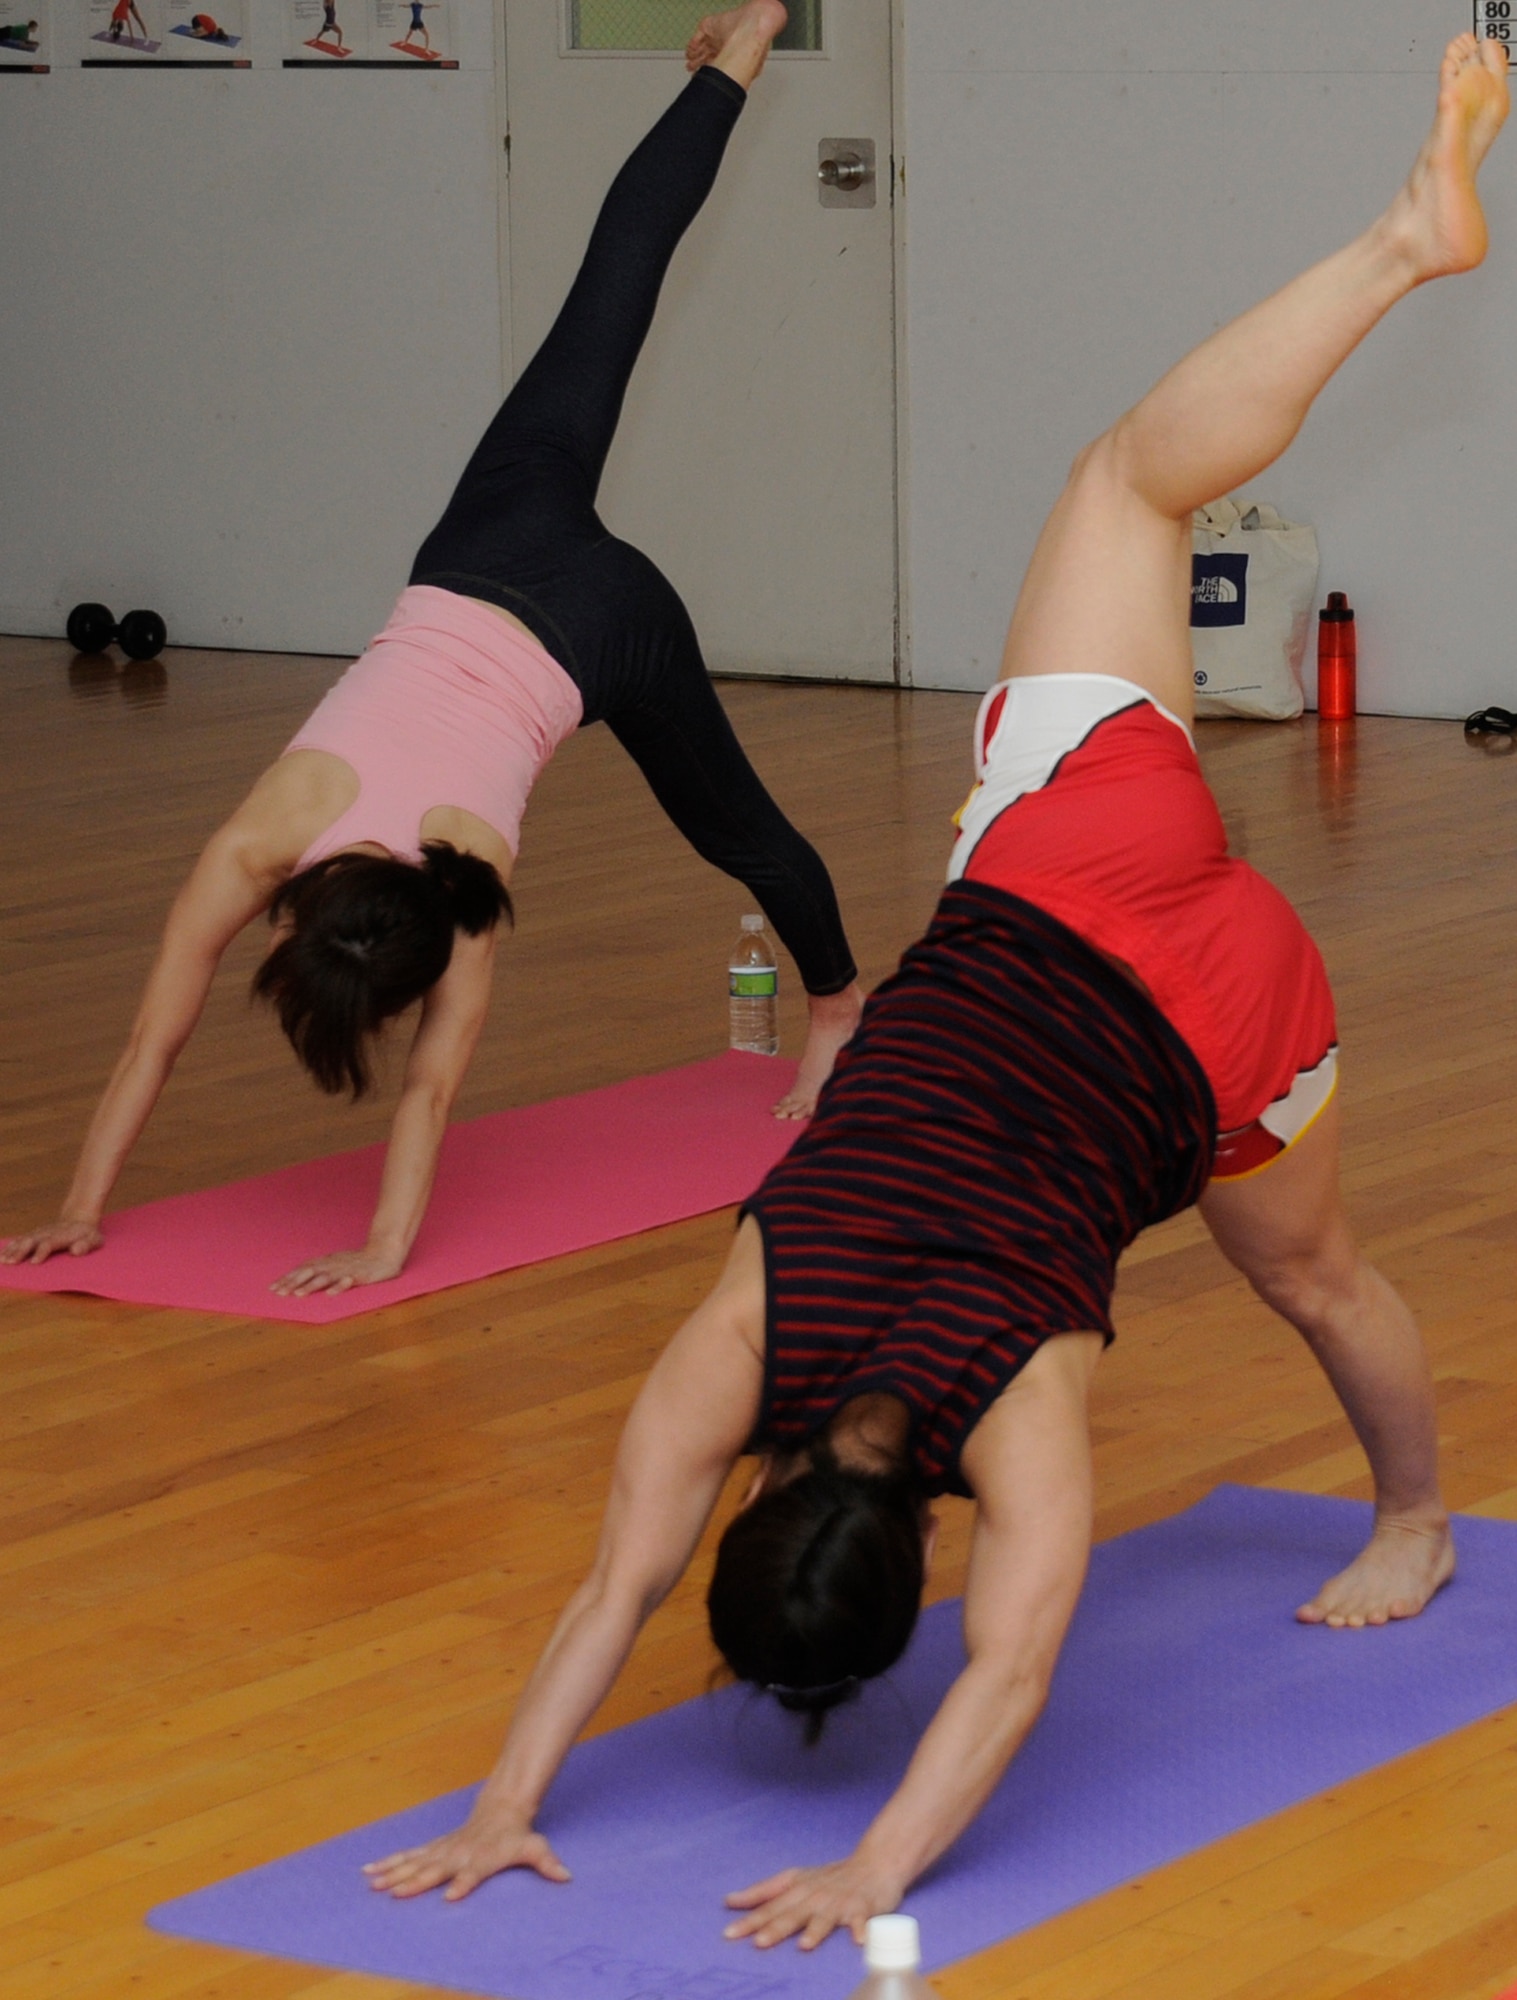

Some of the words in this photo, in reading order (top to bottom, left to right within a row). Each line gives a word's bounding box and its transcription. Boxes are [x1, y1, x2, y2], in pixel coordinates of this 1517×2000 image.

[1485, 1, 1511, 18] 80
[1485, 23, 1511, 40] 85
[1201, 576, 1219, 587] THE
[1191, 585, 1218, 595] ORTH
